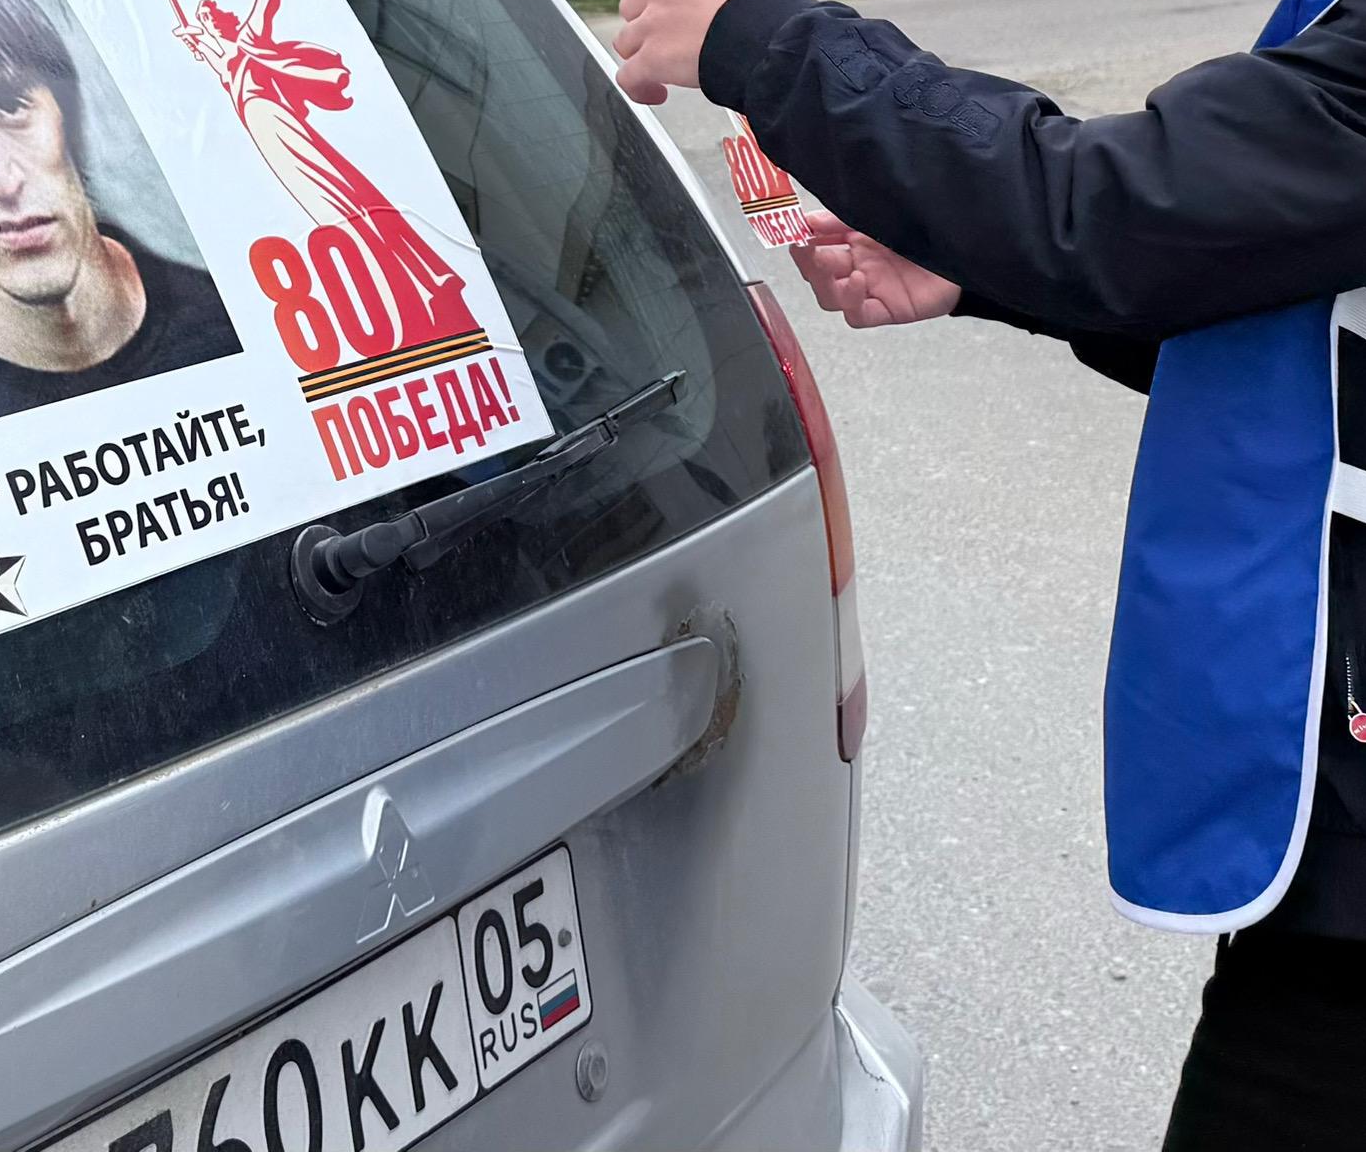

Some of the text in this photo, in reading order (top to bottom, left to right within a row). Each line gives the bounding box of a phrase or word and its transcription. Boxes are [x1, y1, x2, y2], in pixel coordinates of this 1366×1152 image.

[722, 135, 770, 203] 80
[248, 224, 397, 374] 80
[4, 403, 267, 516] РАБОТАЙТЕ,
[311, 357, 523, 482] ПОБЕДА!
[76, 470, 251, 567] БРАТЬЯ!
[473, 876, 554, 1015] 05
[480, 1001, 538, 1071] RUS
